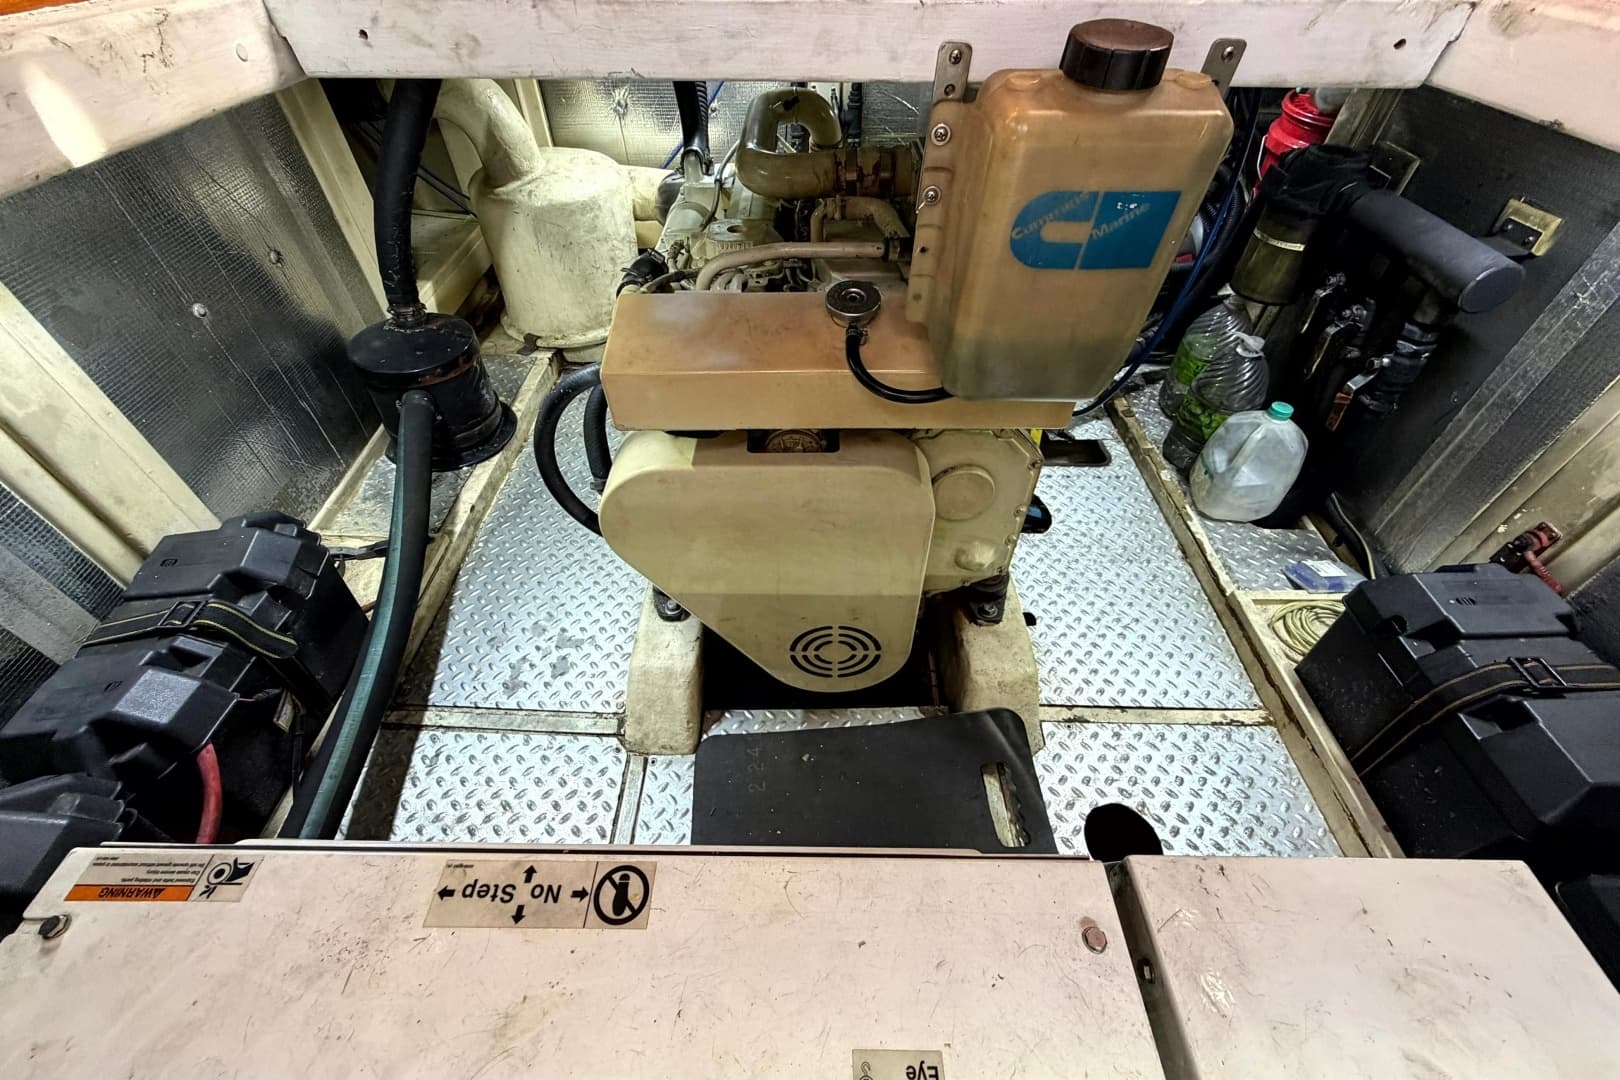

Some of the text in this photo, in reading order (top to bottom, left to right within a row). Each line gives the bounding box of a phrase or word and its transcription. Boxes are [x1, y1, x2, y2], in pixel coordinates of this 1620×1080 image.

[1091, 202, 1151, 240] Marine
[98, 886, 155, 899] WARNING
[461, 878, 562, 904] No Step
[905, 1060, 940, 1080] Eye
